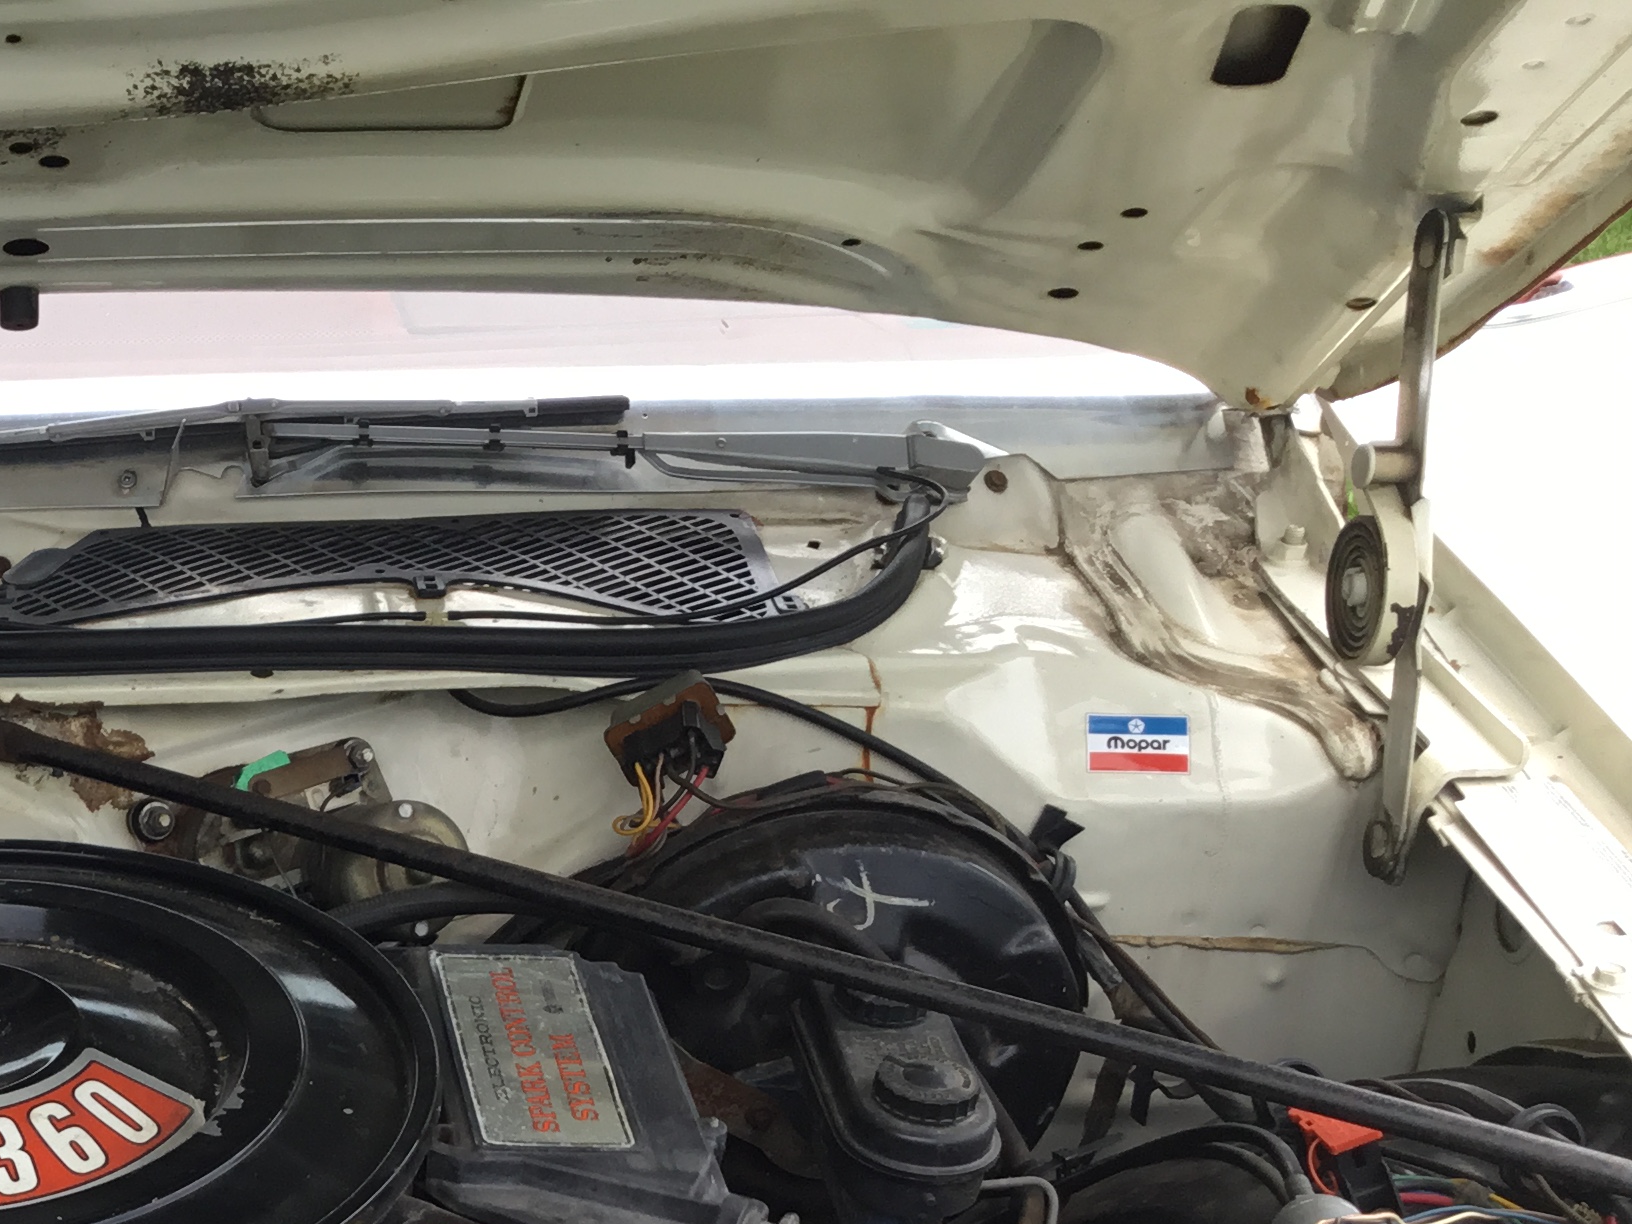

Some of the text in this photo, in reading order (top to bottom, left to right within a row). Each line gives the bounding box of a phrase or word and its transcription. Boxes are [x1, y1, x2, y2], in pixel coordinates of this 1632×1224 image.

[469, 996, 510, 1101] ELECTRONIC
[489, 966, 561, 1134] SPARK CONTROL
[548, 1033, 600, 1122] SYSTEM
